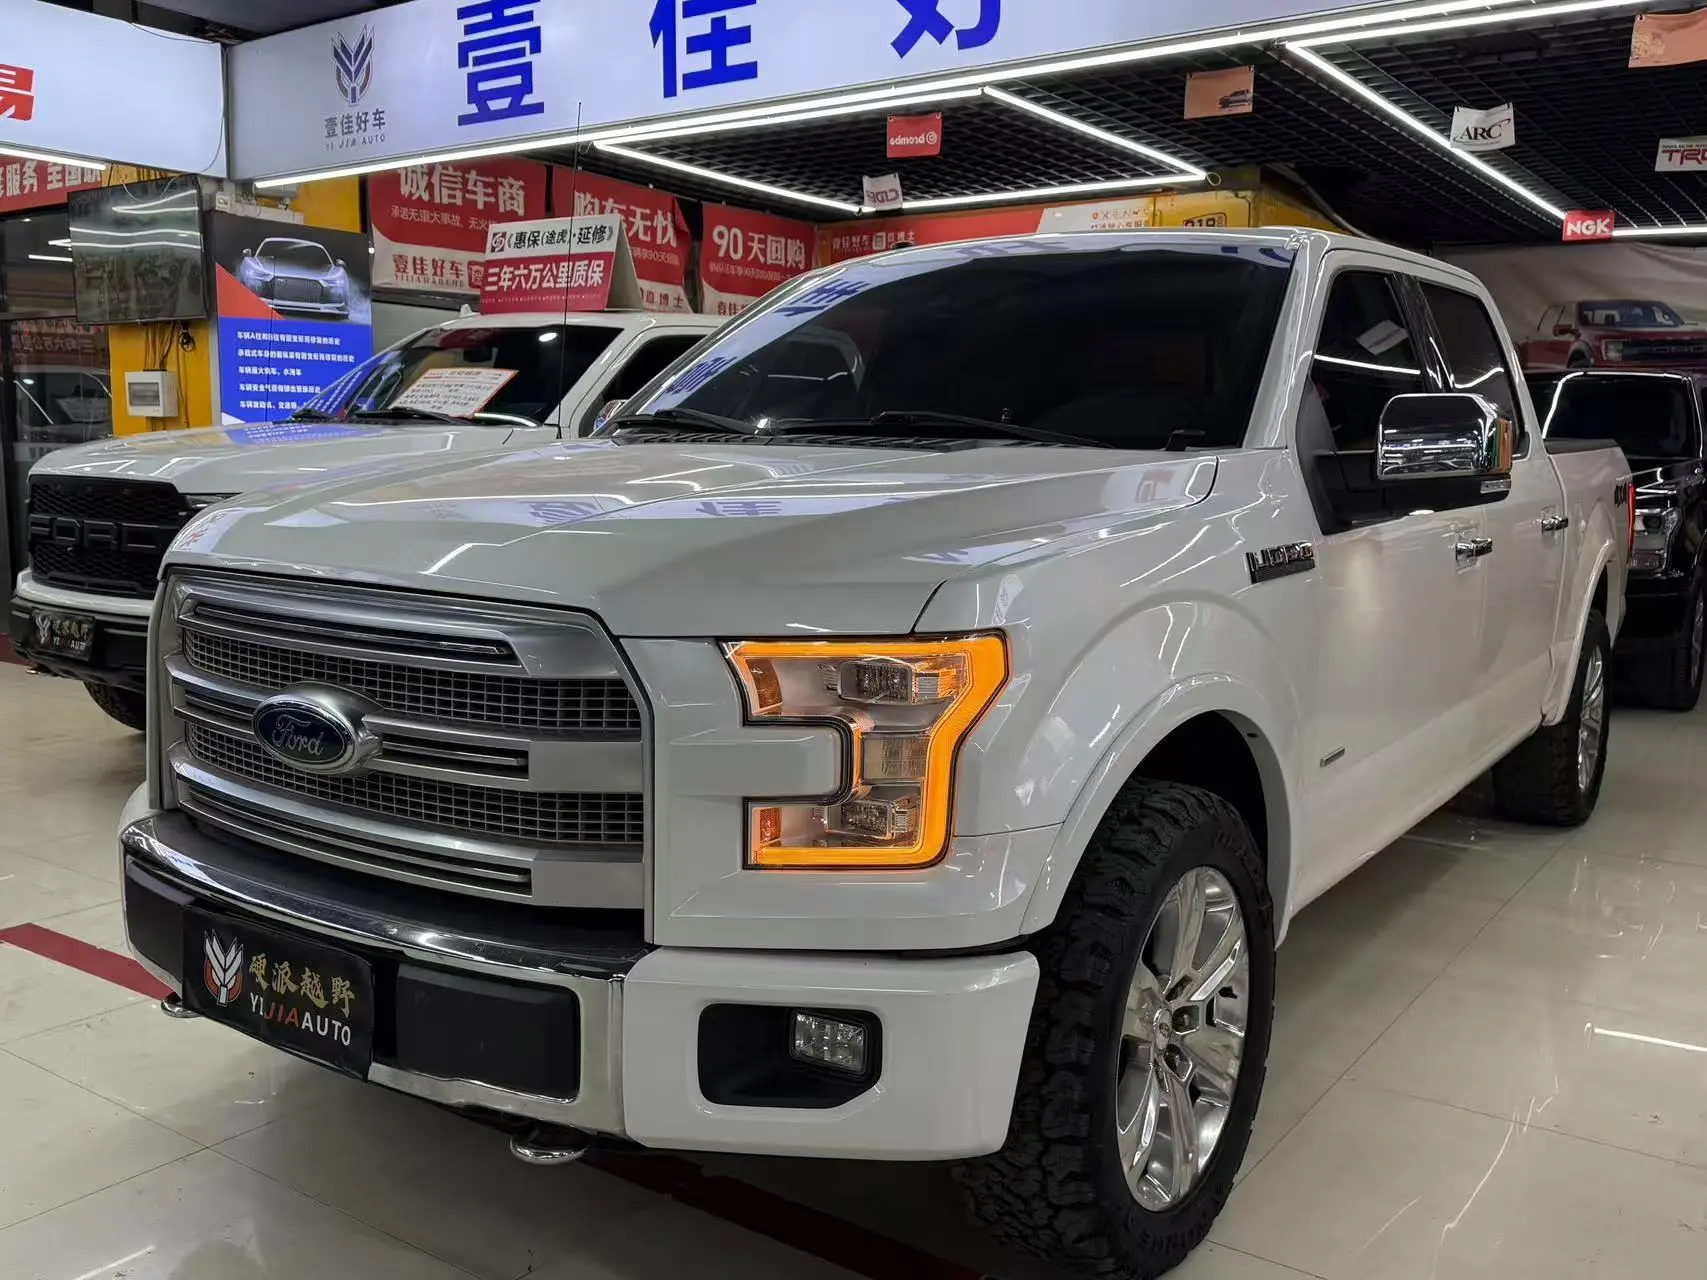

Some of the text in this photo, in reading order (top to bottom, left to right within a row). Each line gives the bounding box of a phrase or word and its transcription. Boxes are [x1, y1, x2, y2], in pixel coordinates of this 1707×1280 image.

[325, 109, 386, 138] 壹佳好车
[362, 133, 386, 145] AUTO
[1460, 123, 1503, 140] ARC
[397, 163, 525, 216] 诚信车商
[1567, 218, 1610, 235] NGK
[712, 225, 805, 270] 90天回购
[392, 254, 465, 279] 壹佳好车
[485, 260, 605, 292] 三年六万公里质保
[270, 713, 325, 757] Ford
[248, 953, 356, 1019] 硬派越野
[250, 992, 352, 1047] YIJIAAUTO
